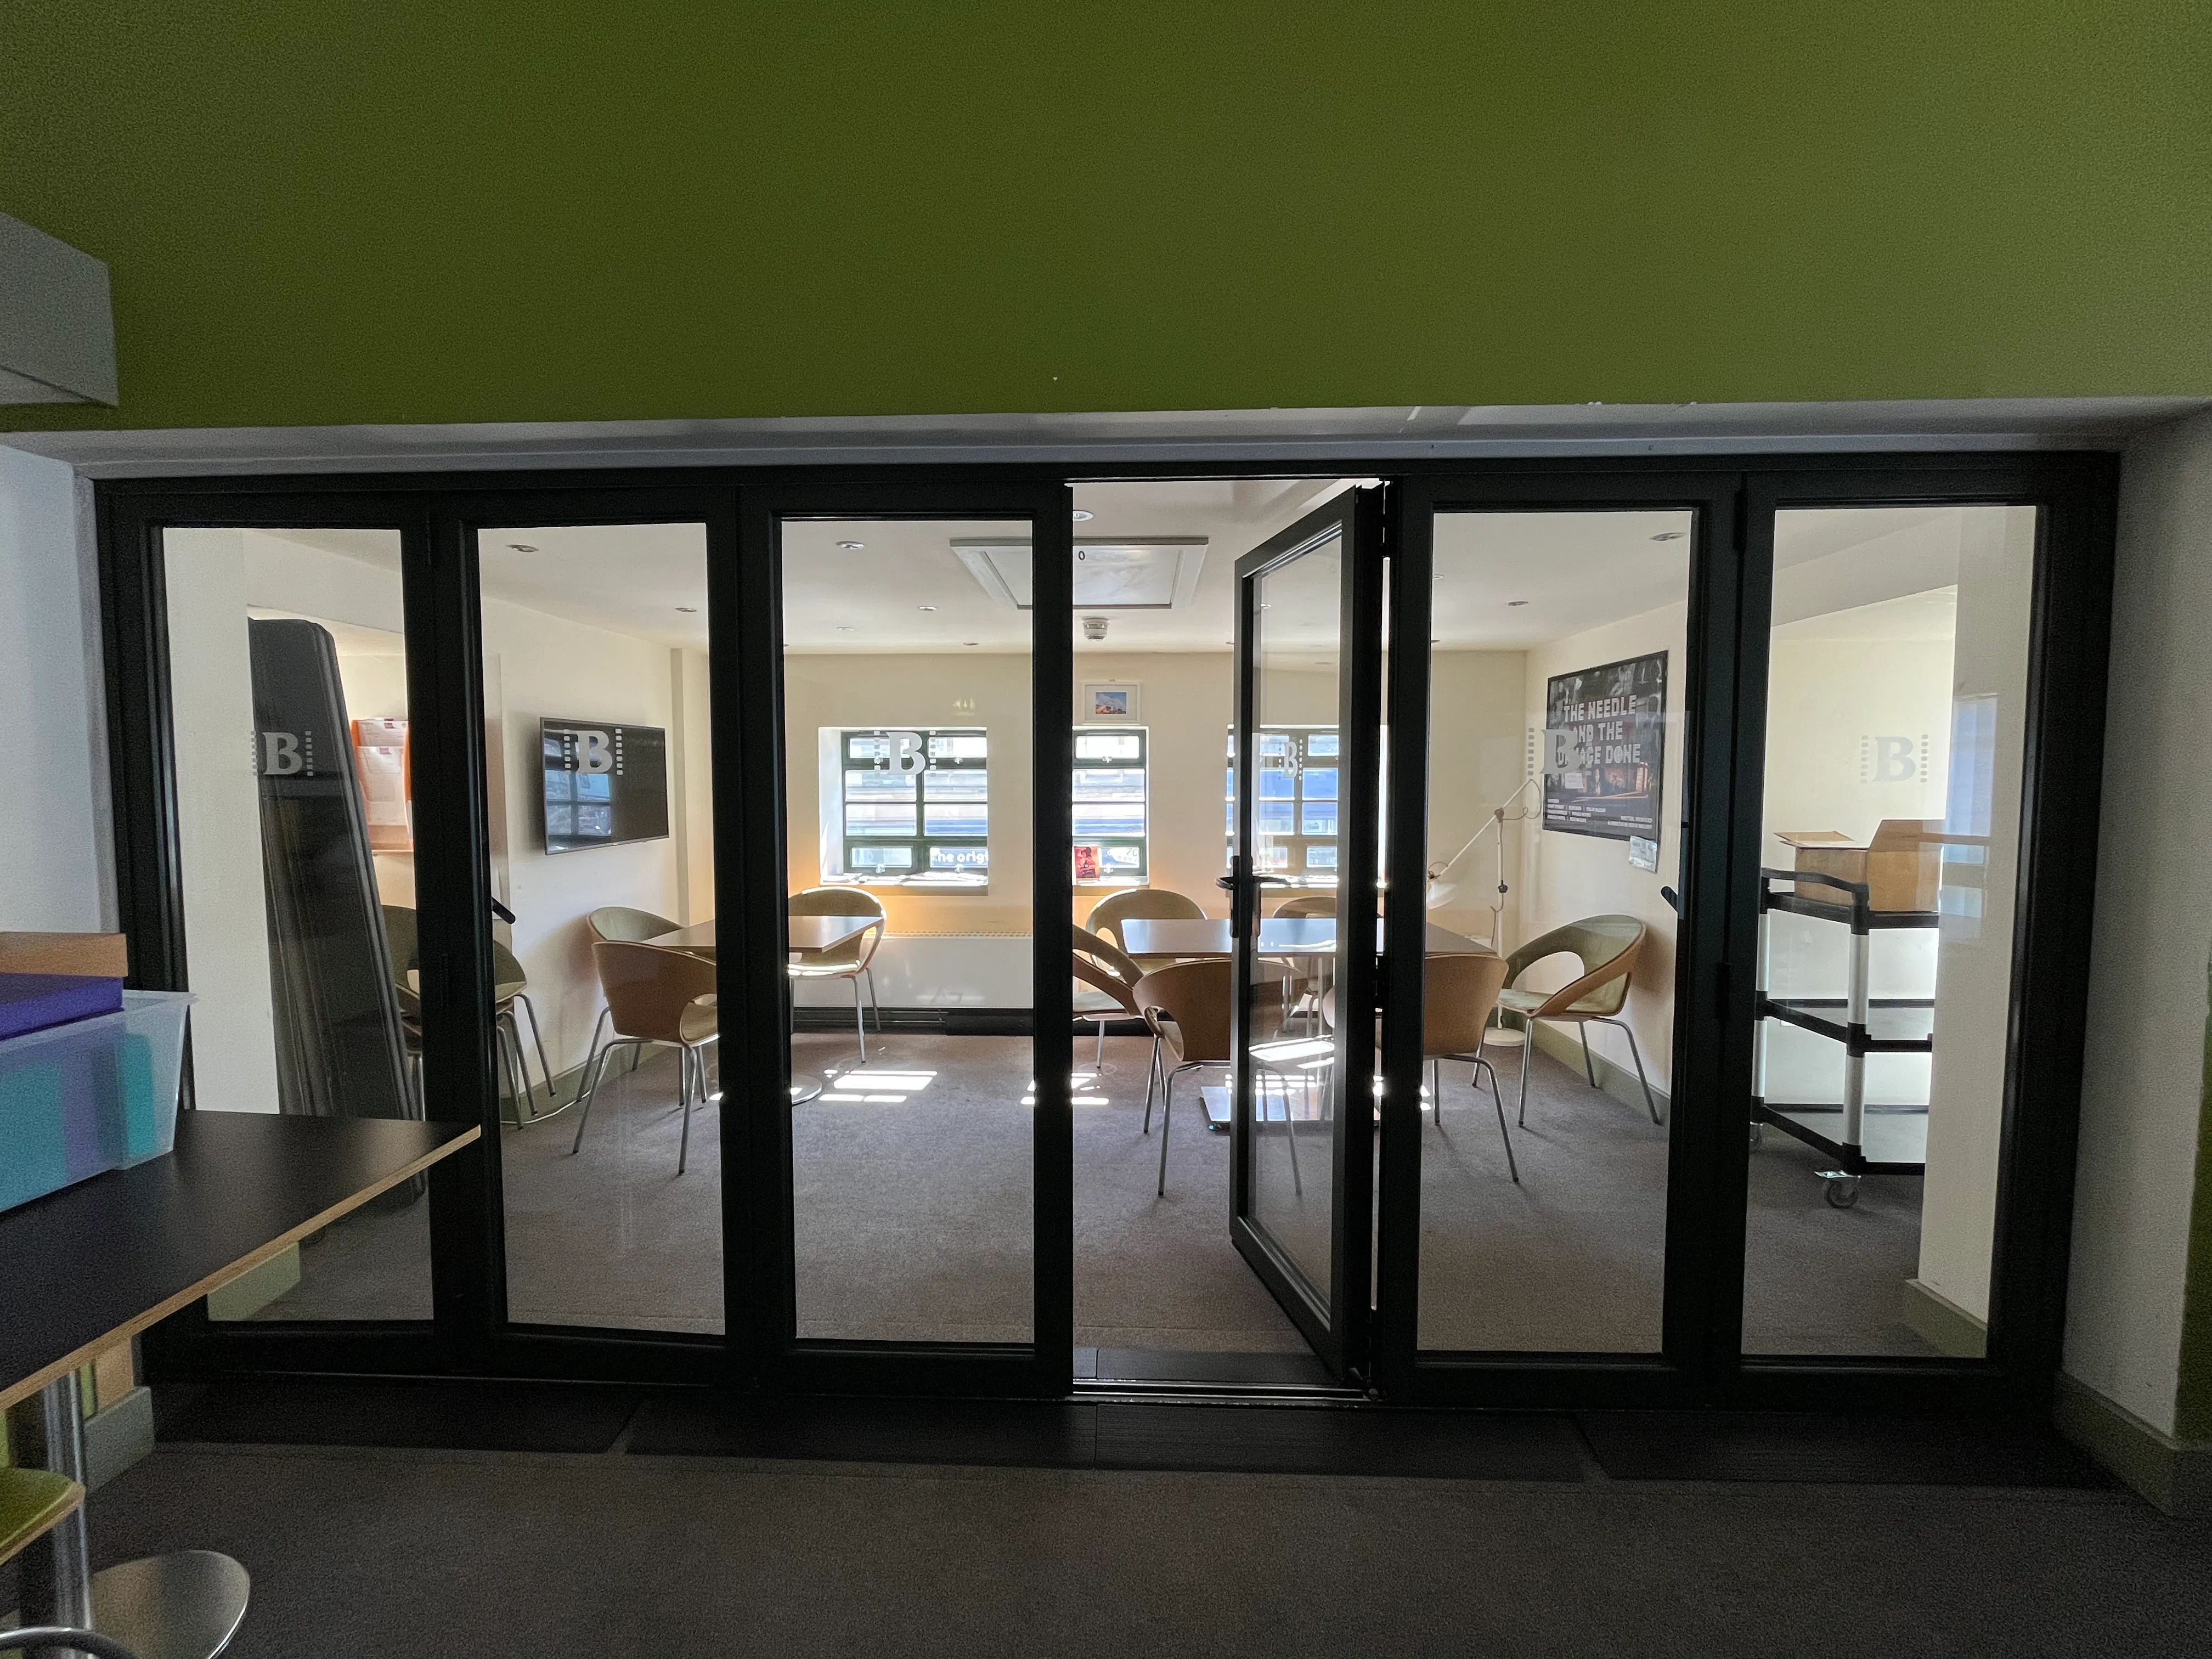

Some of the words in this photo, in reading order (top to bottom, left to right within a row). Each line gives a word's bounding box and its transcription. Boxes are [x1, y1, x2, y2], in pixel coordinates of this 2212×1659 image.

[1564, 703, 1584, 722] THE
[1588, 695, 1637, 720] NEEDLE
[1598, 721, 1623, 741] THE
[261, 732, 302, 775] B
[575, 730, 613, 774] B
[885, 732, 926, 775] B
[1283, 741, 1298, 778] B
[1539, 729, 1581, 774] B
[1605, 743, 1640, 764] DONE
[1872, 736, 1916, 782] B
[933, 849, 955, 862] he
